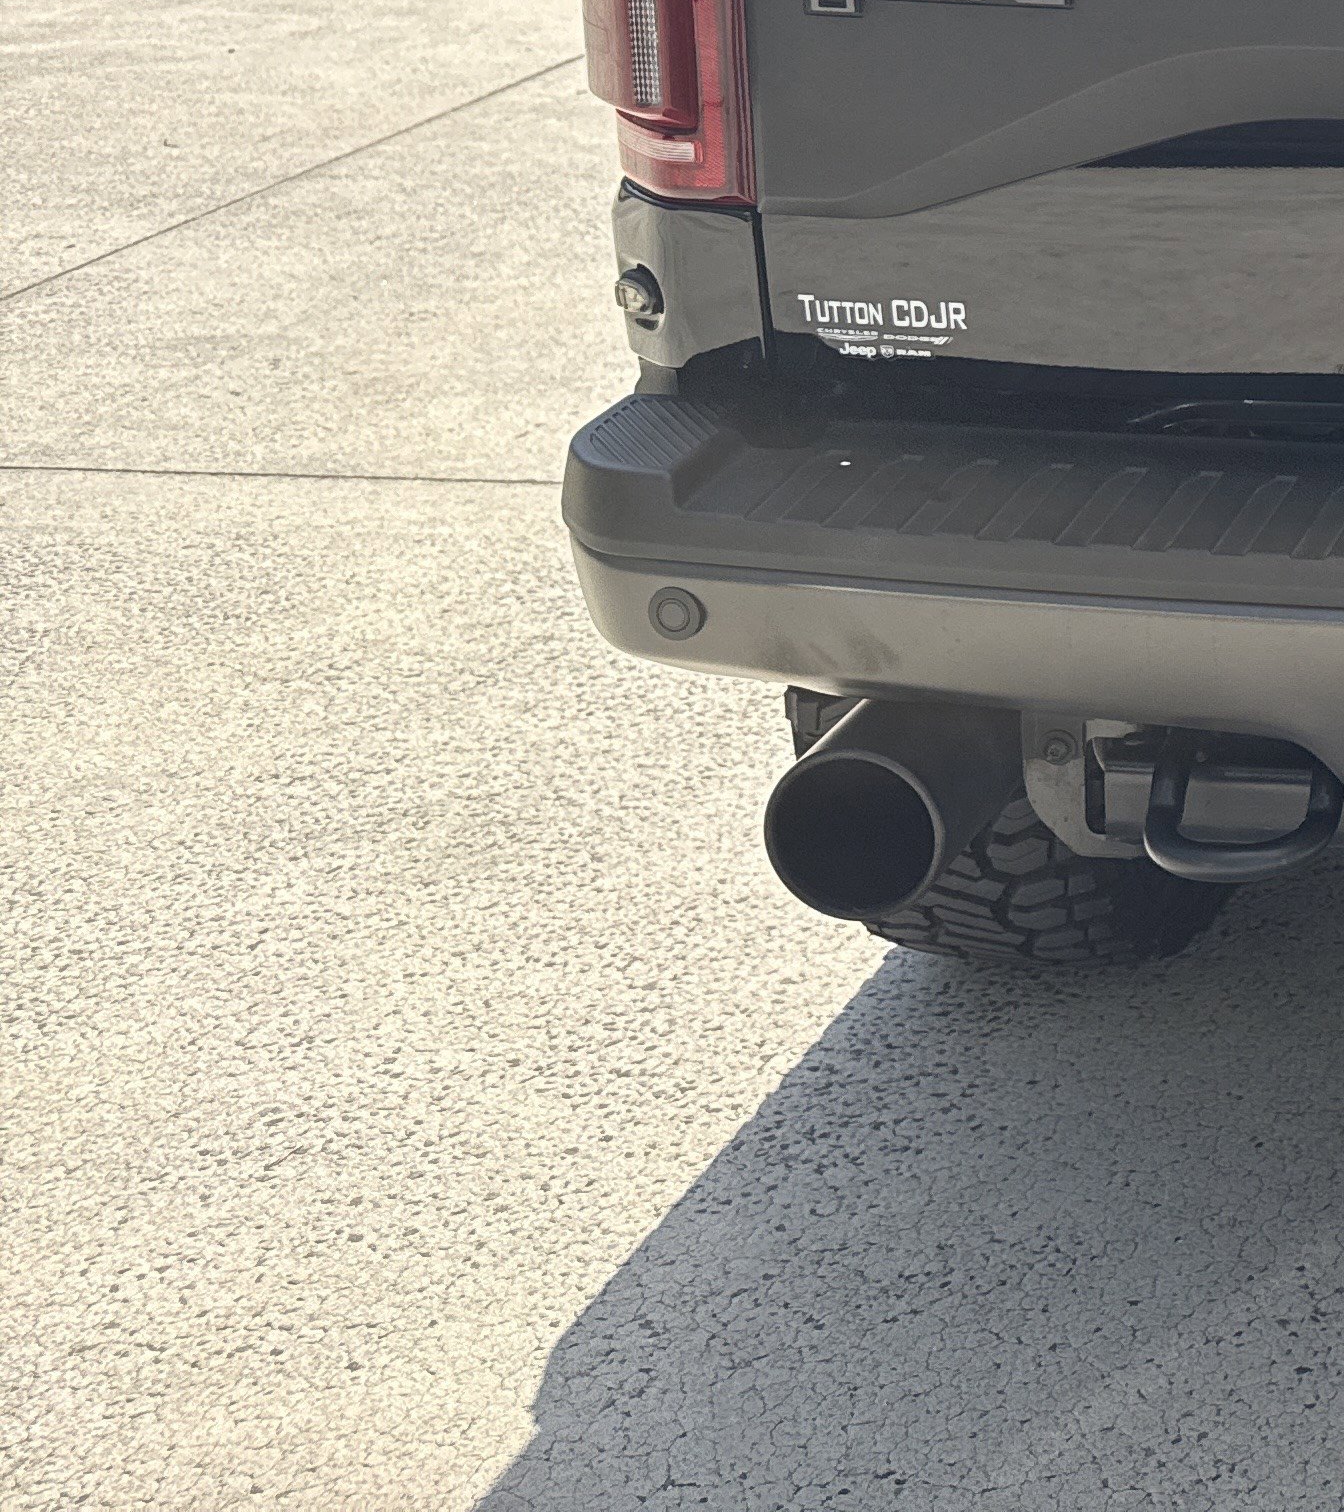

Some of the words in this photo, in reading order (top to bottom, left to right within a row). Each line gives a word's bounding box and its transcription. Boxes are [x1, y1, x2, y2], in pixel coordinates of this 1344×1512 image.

[798, 294, 883, 326] TUTTON
[891, 299, 967, 330] CDJR
[839, 342, 877, 358] Jeep
